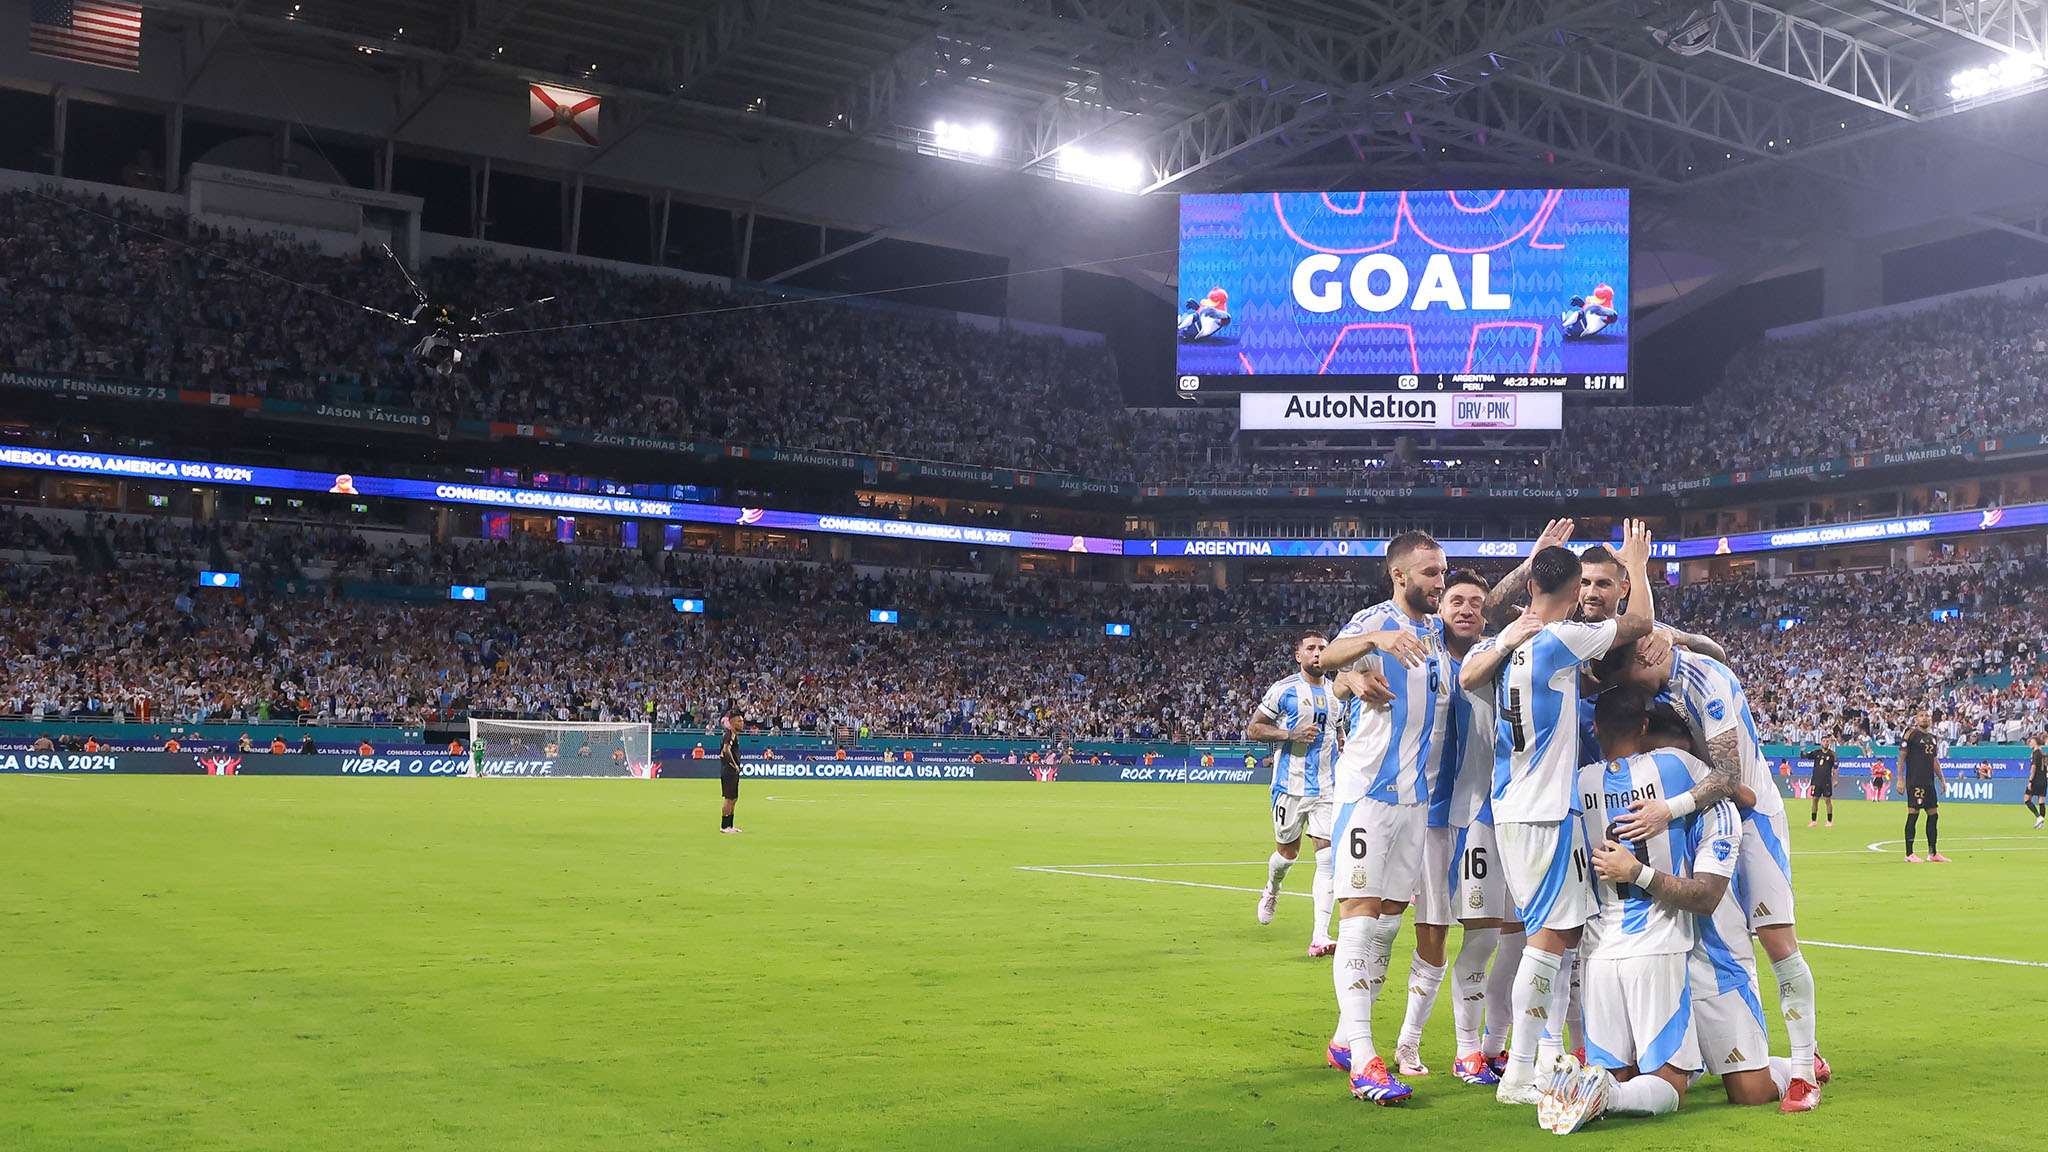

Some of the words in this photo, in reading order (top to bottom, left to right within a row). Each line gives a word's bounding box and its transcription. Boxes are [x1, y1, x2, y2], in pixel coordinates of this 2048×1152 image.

[1292, 253, 1510, 312] GOAL
[1463, 383, 1484, 391] PERU
[1530, 377, 1549, 387] 2ND
[1550, 376, 1568, 386] Half
[1609, 376, 1625, 390] PM
[147, 388, 167, 399] 75
[1285, 395, 1437, 418] AutoNation
[1458, 402, 1481, 419] DRV
[1487, 402, 1510, 419] PNK
[421, 415, 431, 426] 9
[680, 442, 695, 452] 54
[57, 455, 103, 471] COPA
[102, 458, 178, 476] AMERICA
[181, 464, 212, 480] USA
[214, 467, 251, 482] 2024
[1820, 462, 1832, 472] 62
[1566, 488, 1579, 497] 39
[436, 485, 514, 503] CONMEBOL
[515, 491, 552, 506] COPA
[552, 495, 612, 512] AMERICA
[614, 500, 639, 513] USA
[640, 502, 672, 516] 2024
[819, 517, 883, 533] CONMEBOL
[883, 523, 914, 536] COPA
[914, 525, 962, 540] AMERICA
[964, 529, 984, 542] USA
[1771, 531, 1819, 546] CONMEBOL
[1819, 528, 1845, 541] COPA
[1845, 524, 1886, 539] AMERICA
[1150, 542, 1158, 555] 1
[1184, 541, 1272, 555] ARGENTINA
[1337, 541, 1349, 555] 0
[1477, 542, 1518, 556] 46:28
[1661, 543, 1676, 556] PM
[1924, 744, 1935, 754] 22
[25, 755, 63, 770] USA
[68, 755, 116, 770] 2024
[342, 760, 400, 773] VIBRA
[409, 760, 423, 773] O
[429, 760, 554, 775] CONINENTE
[815, 764, 850, 777] COPA
[854, 765, 913, 778] AMERICA
[917, 765, 941, 778] USA
[943, 766, 973, 778] 2024
[1120, 768, 1153, 780] ROCK
[1158, 769, 1187, 781] THE
[1188, 769, 1254, 782] CONTINENT
[1914, 787, 1925, 798] 22
[1945, 782, 1994, 799] MIAMI
[1585, 793, 1598, 809] DI
[1275, 804, 1286, 826] 19
[1350, 827, 1367, 860] 6
[1464, 847, 1488, 880] 16
